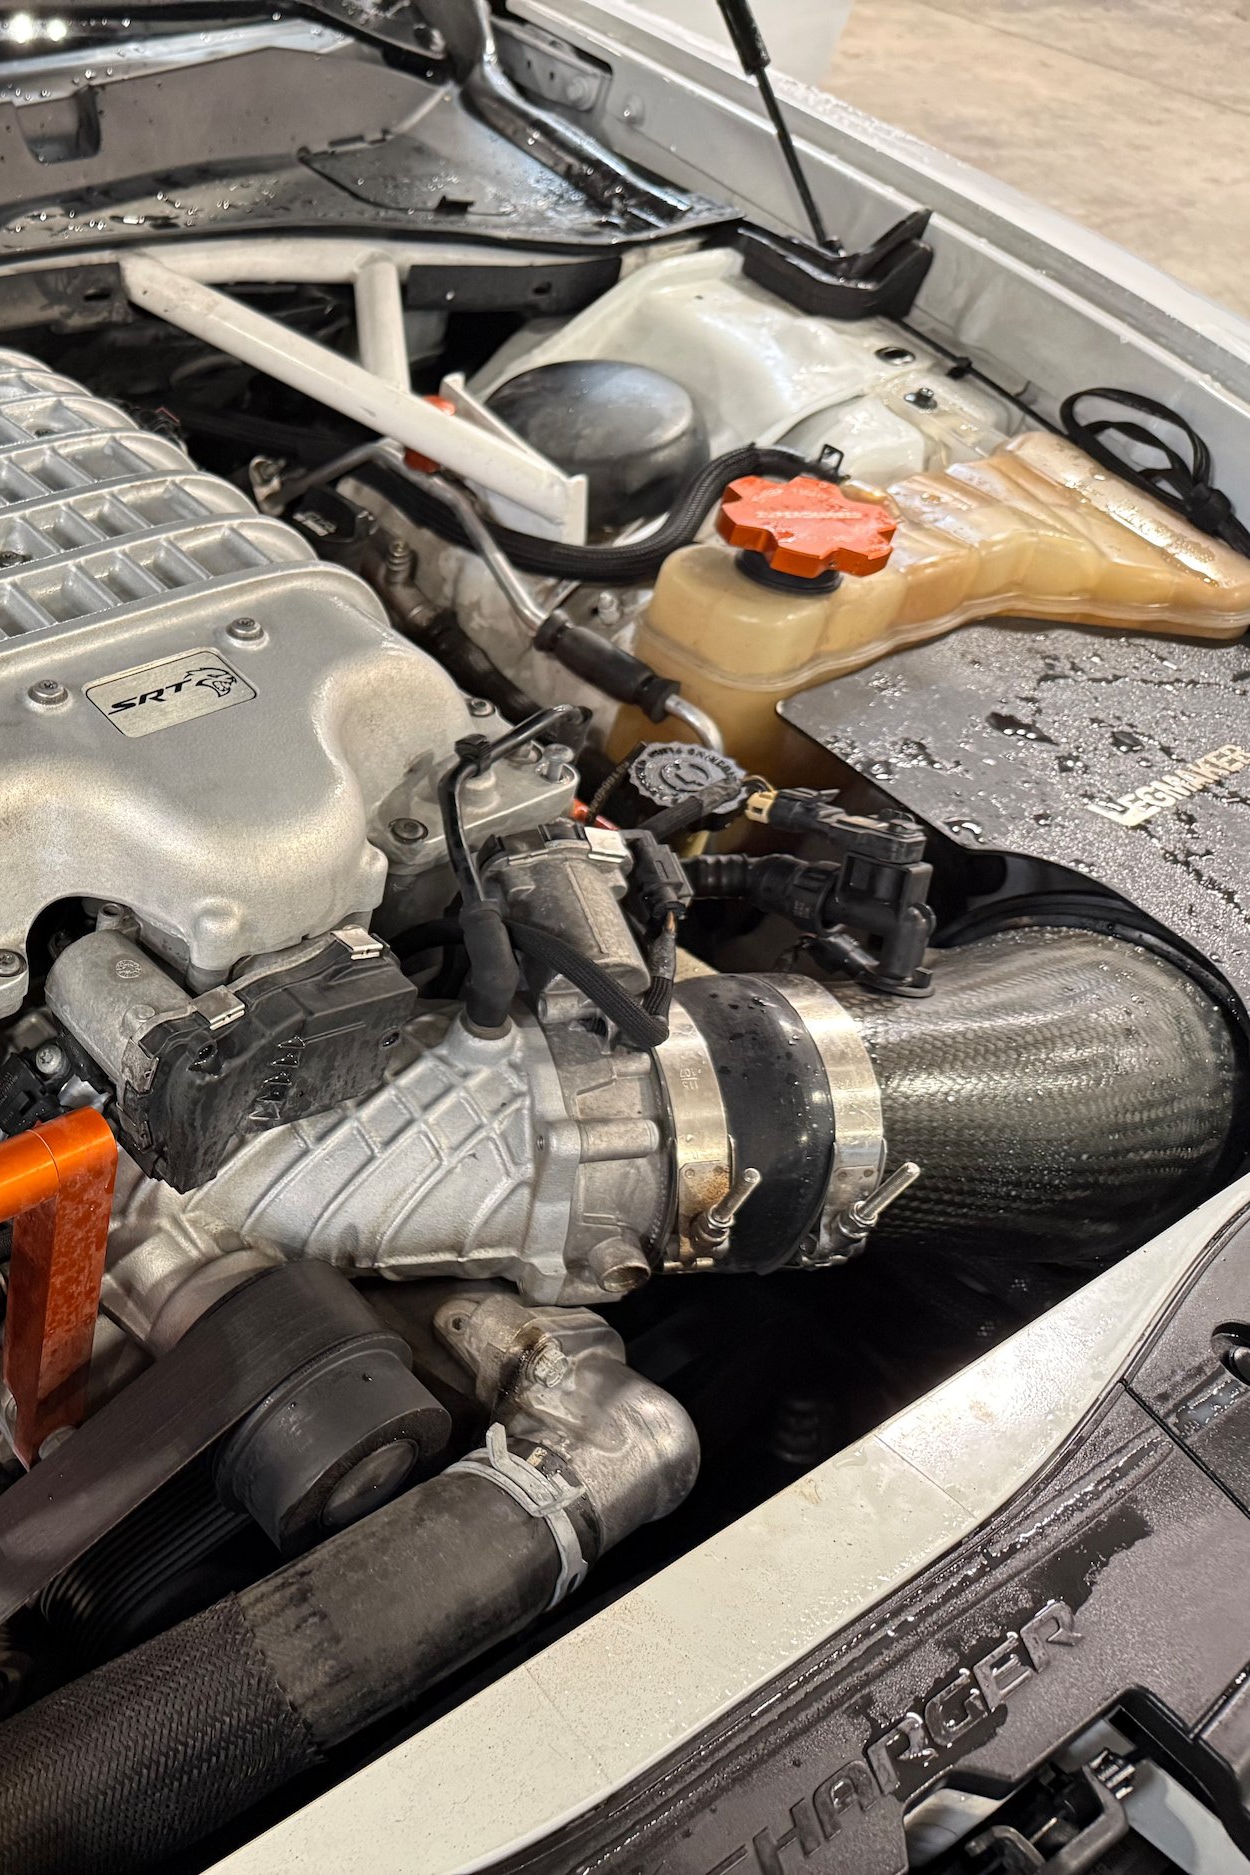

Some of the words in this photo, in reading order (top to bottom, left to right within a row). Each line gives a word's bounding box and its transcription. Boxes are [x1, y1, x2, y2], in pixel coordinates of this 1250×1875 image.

[108, 678, 192, 716] SRT
[1086, 744, 1250, 827] LEGMAKER
[705, 1598, 1084, 1875] HARGER
